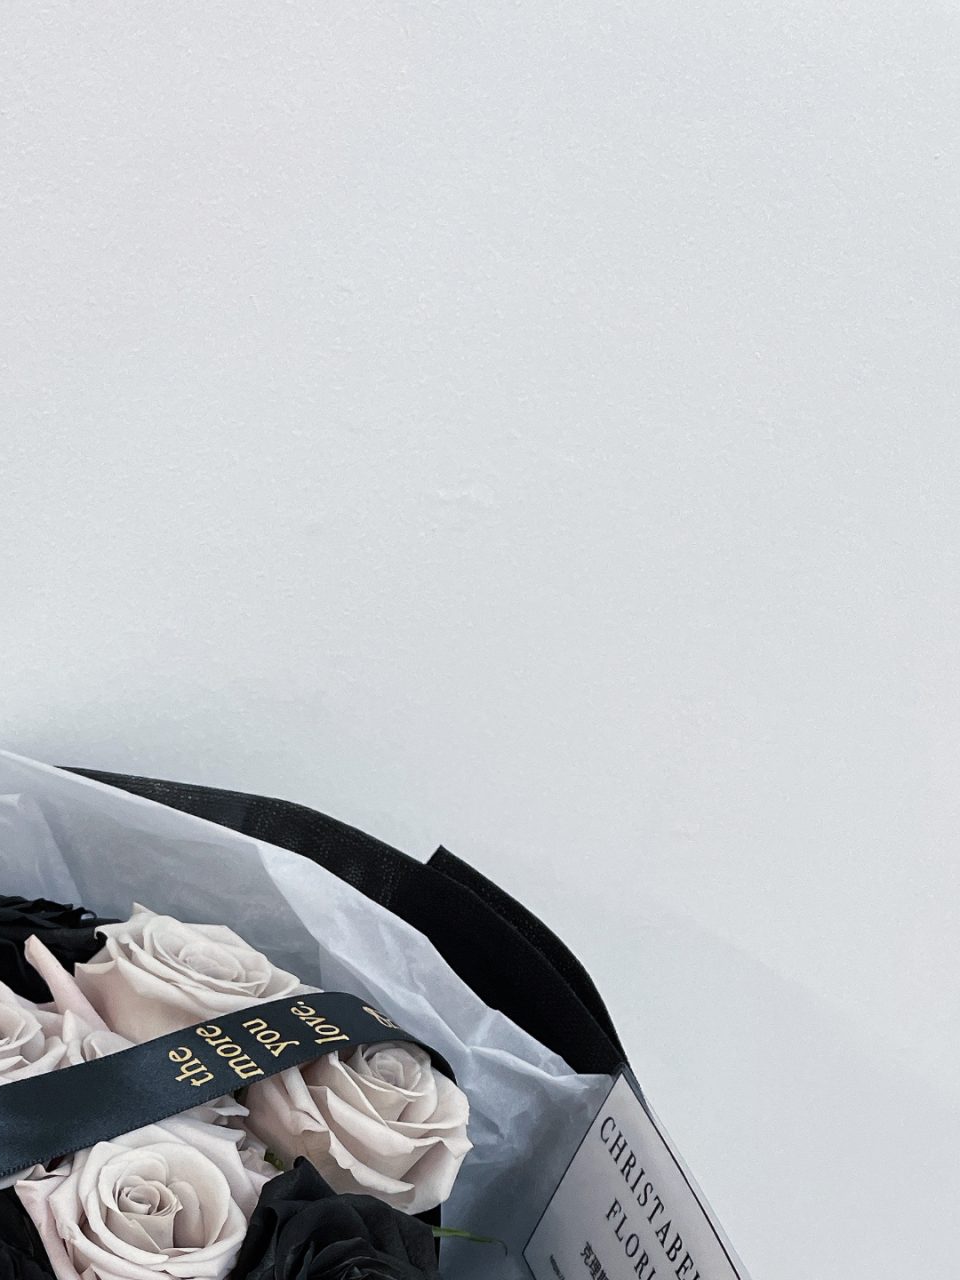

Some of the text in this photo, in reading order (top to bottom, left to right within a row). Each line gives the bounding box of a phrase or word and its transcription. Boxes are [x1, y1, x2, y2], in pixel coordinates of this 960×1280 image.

[242, 1018, 299, 1057] you
[291, 1001, 349, 1045] love.
[169, 1047, 214, 1086] the
[196, 1024, 264, 1079] more
